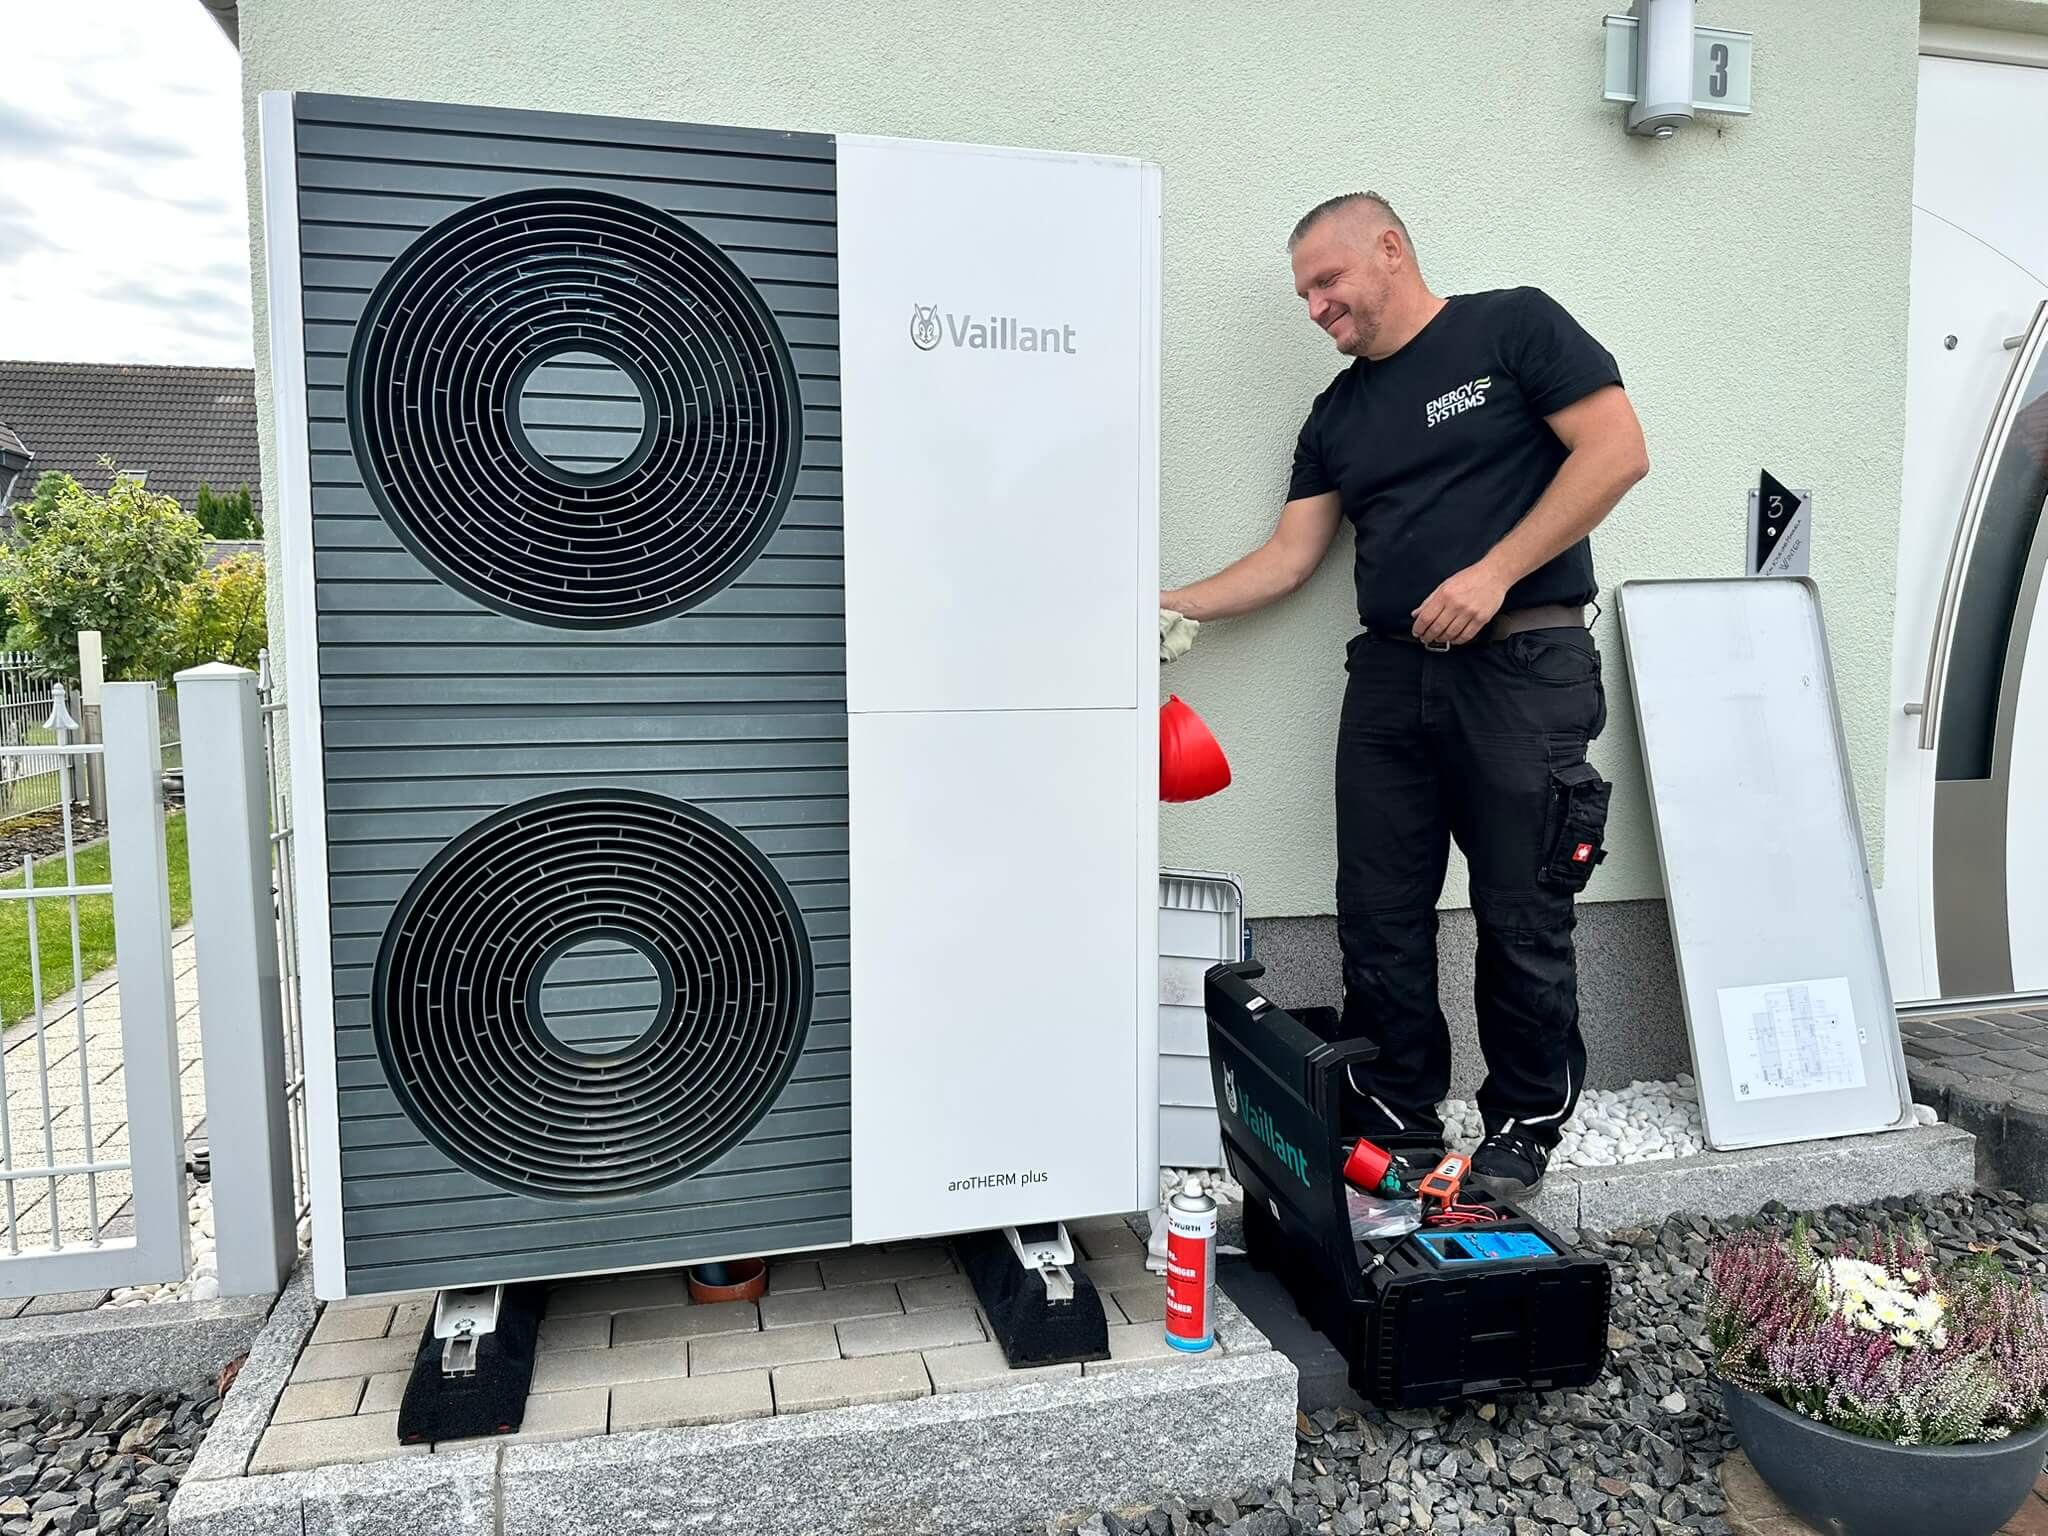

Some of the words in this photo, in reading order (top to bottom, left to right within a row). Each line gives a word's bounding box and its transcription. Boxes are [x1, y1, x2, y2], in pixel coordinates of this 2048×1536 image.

[1709, 43, 1729, 98] 3
[946, 313, 1076, 354] Vaillant
[1426, 381, 1473, 415] ENERGY
[1427, 390, 1486, 427] SYSTEMS
[1767, 495, 1784, 519] 3
[1237, 1086, 1311, 1188] Vaillant
[948, 1173, 1016, 1192] aroTHERM
[1021, 1170, 1048, 1188] plus
